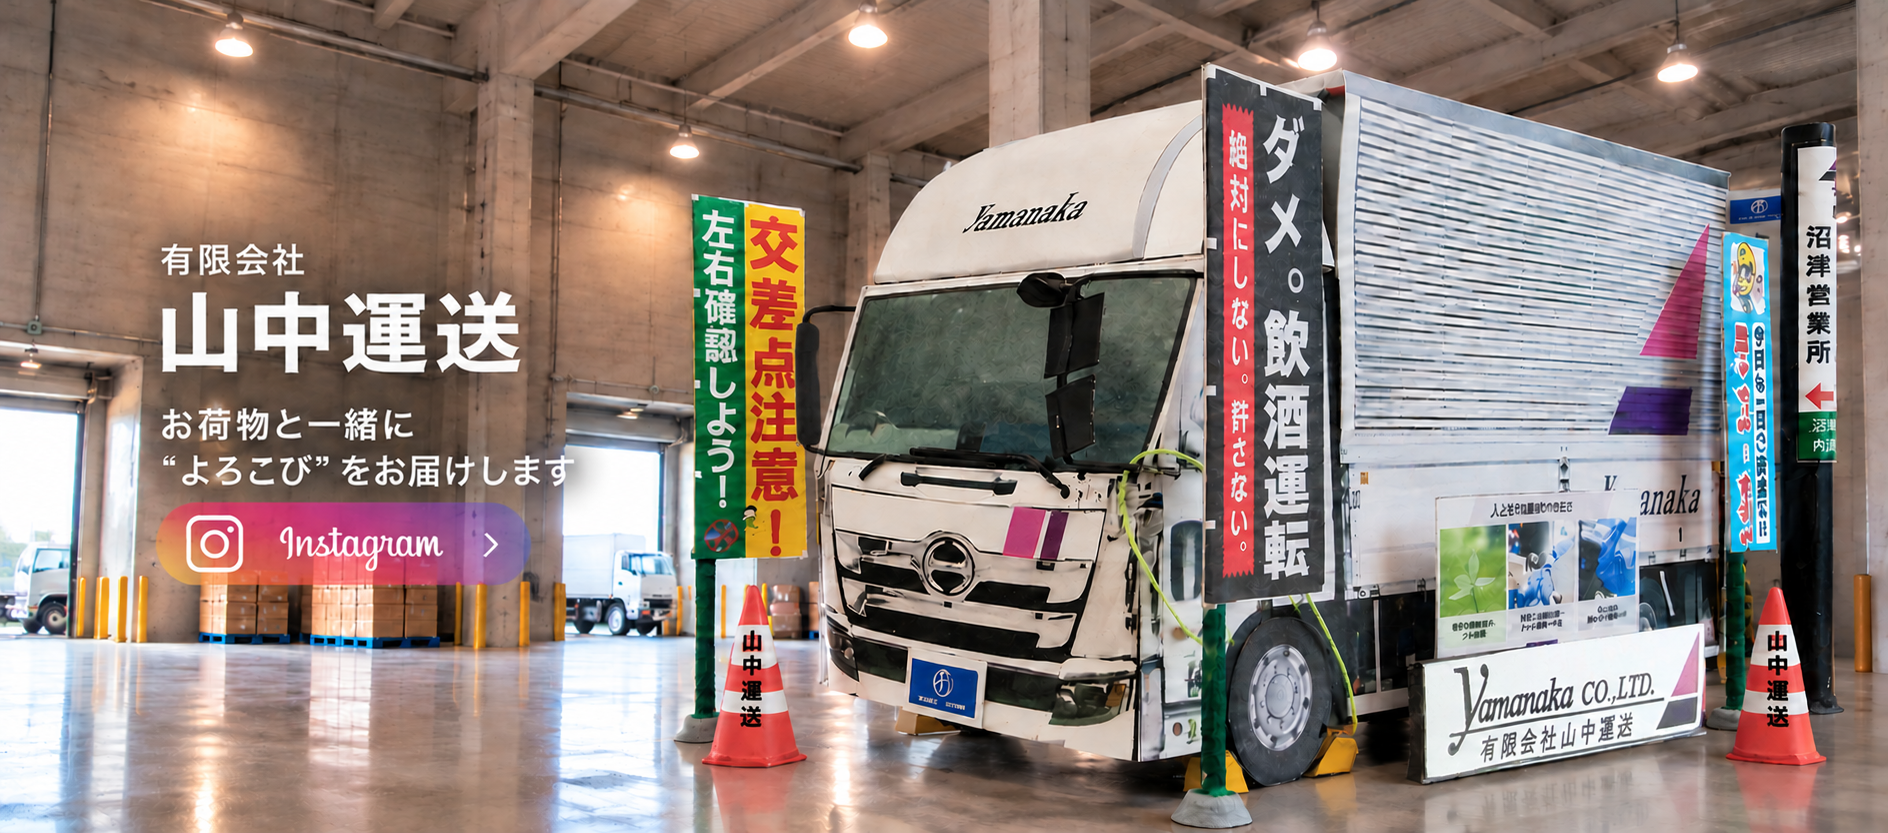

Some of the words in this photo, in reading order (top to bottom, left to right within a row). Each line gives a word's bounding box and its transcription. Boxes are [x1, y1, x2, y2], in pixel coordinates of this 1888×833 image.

[962, 192, 1088, 233] Yamanaka
[1806, 225, 1832, 364] 沼津営業所
[741, 630, 762, 728] 山中運送
[1448, 664, 1574, 755] Yamanaka
[1767, 631, 1789, 727] 山中運送
[1480, 712, 1633, 763] 有限会社山中運送
